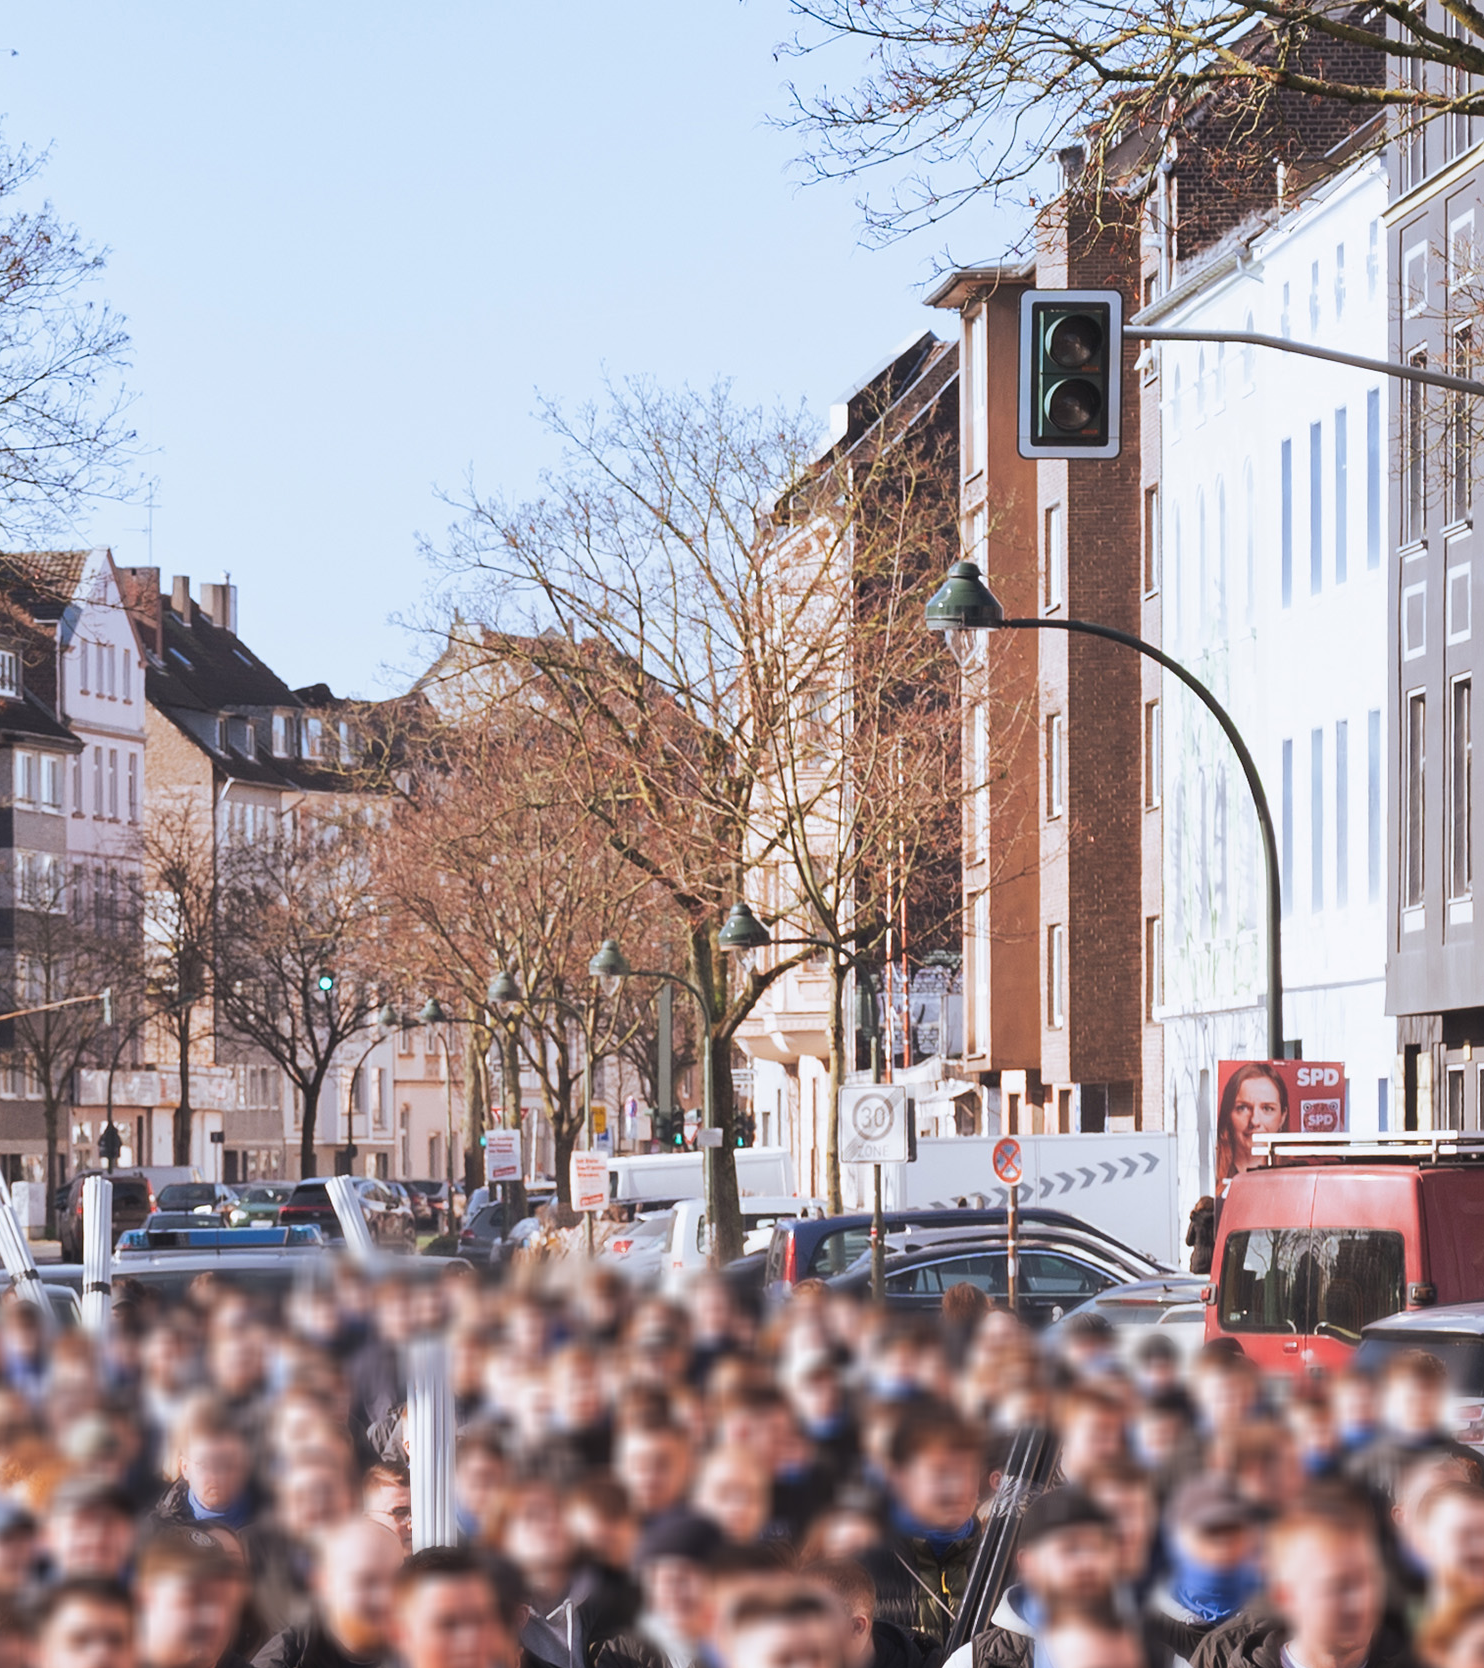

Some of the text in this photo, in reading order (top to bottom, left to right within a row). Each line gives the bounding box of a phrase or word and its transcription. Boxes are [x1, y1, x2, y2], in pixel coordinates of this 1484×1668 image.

[1297, 1068, 1339, 1087] SPD
[861, 1106, 885, 1128] 30
[1308, 1114, 1333, 1126] SPD
[858, 1145, 889, 1157] ZONE
